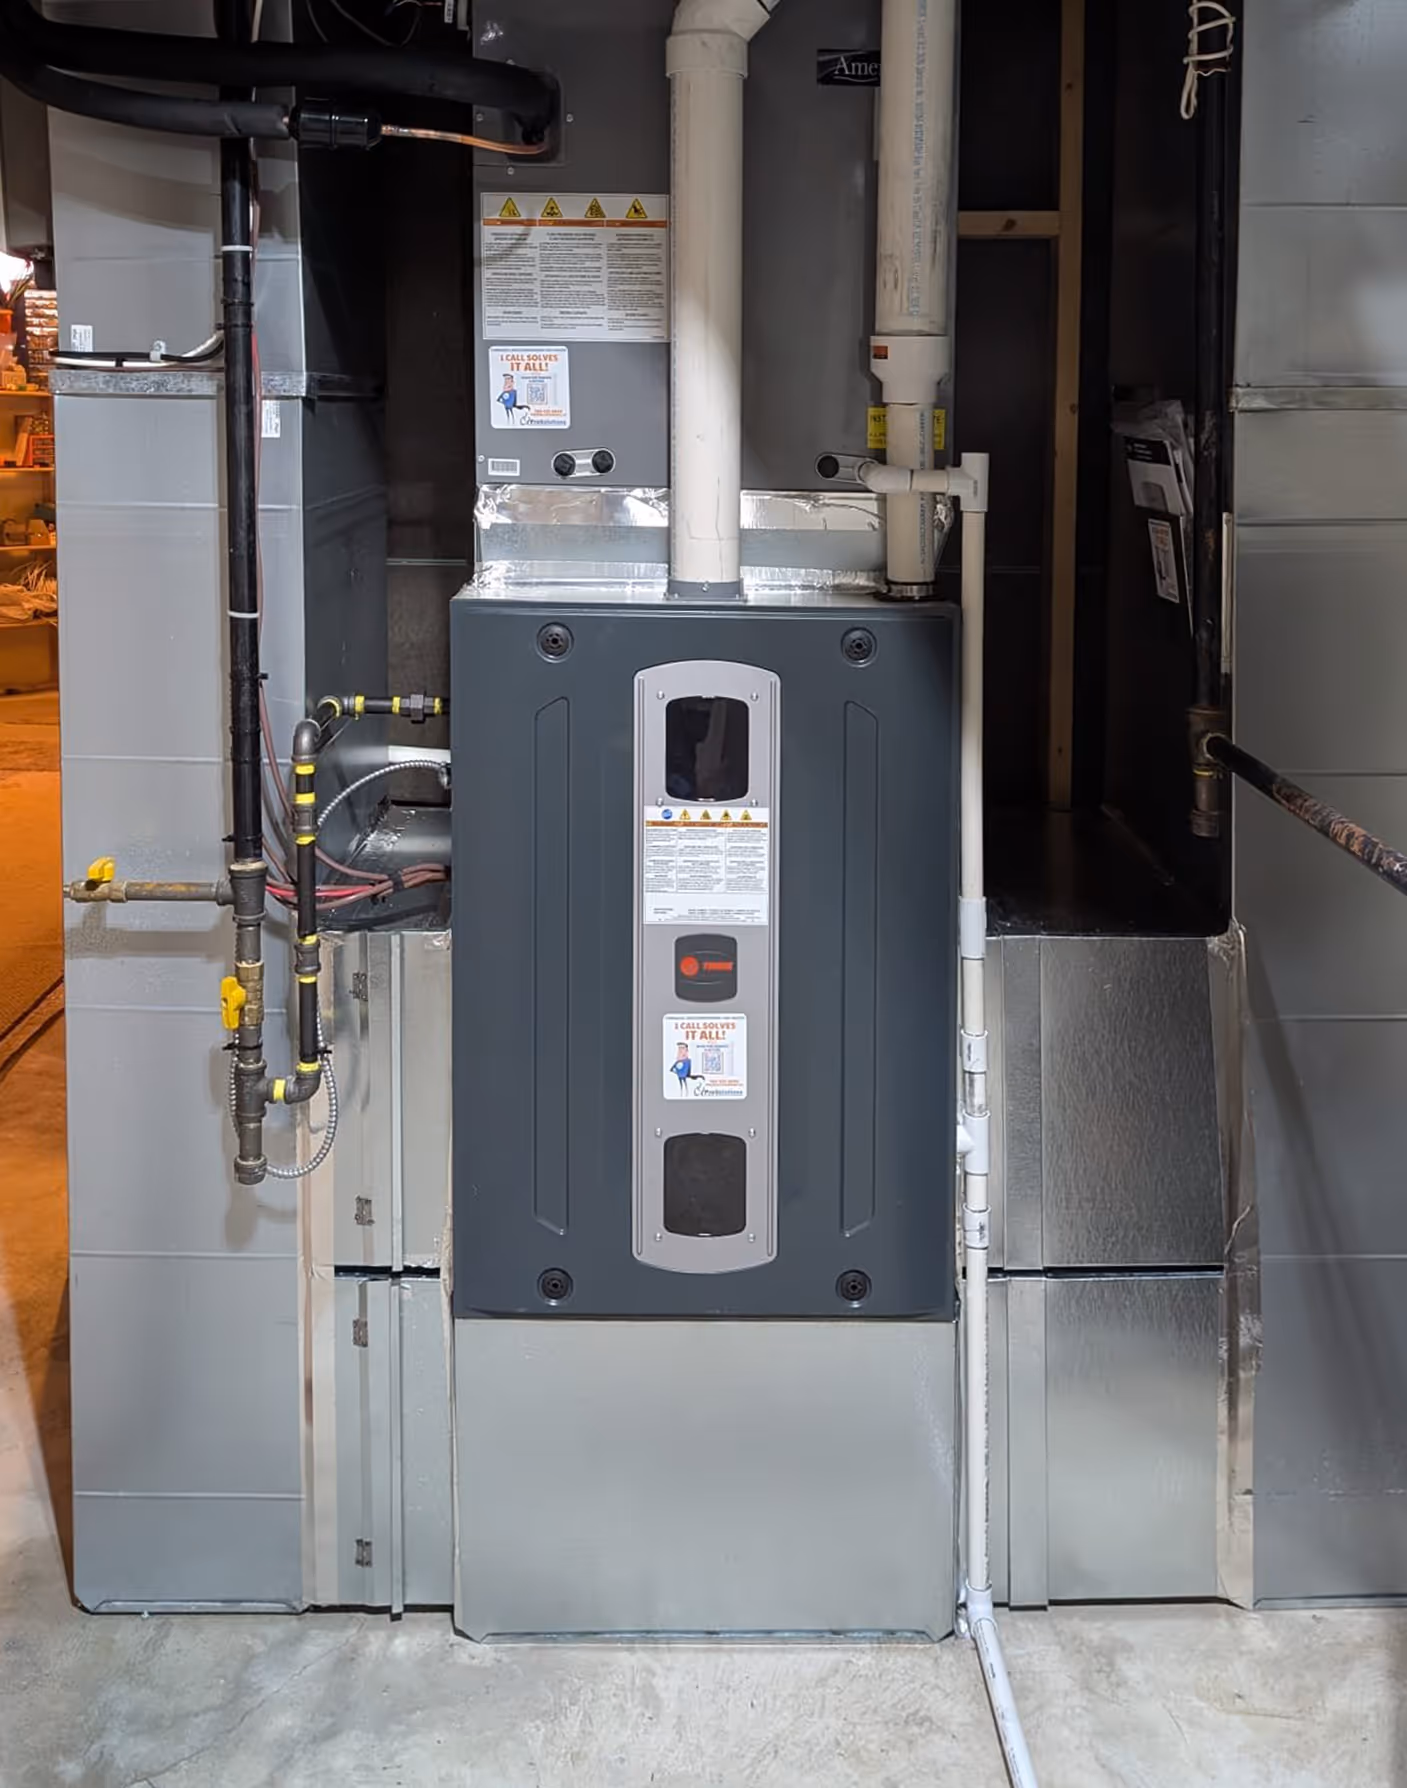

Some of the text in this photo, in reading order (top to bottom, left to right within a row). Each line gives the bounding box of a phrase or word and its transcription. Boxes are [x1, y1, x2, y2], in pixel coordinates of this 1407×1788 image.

[834, 55, 880, 76] Ame
[510, 362, 549, 371] IT ALL!
[685, 1031, 726, 1040] IT ALL!
